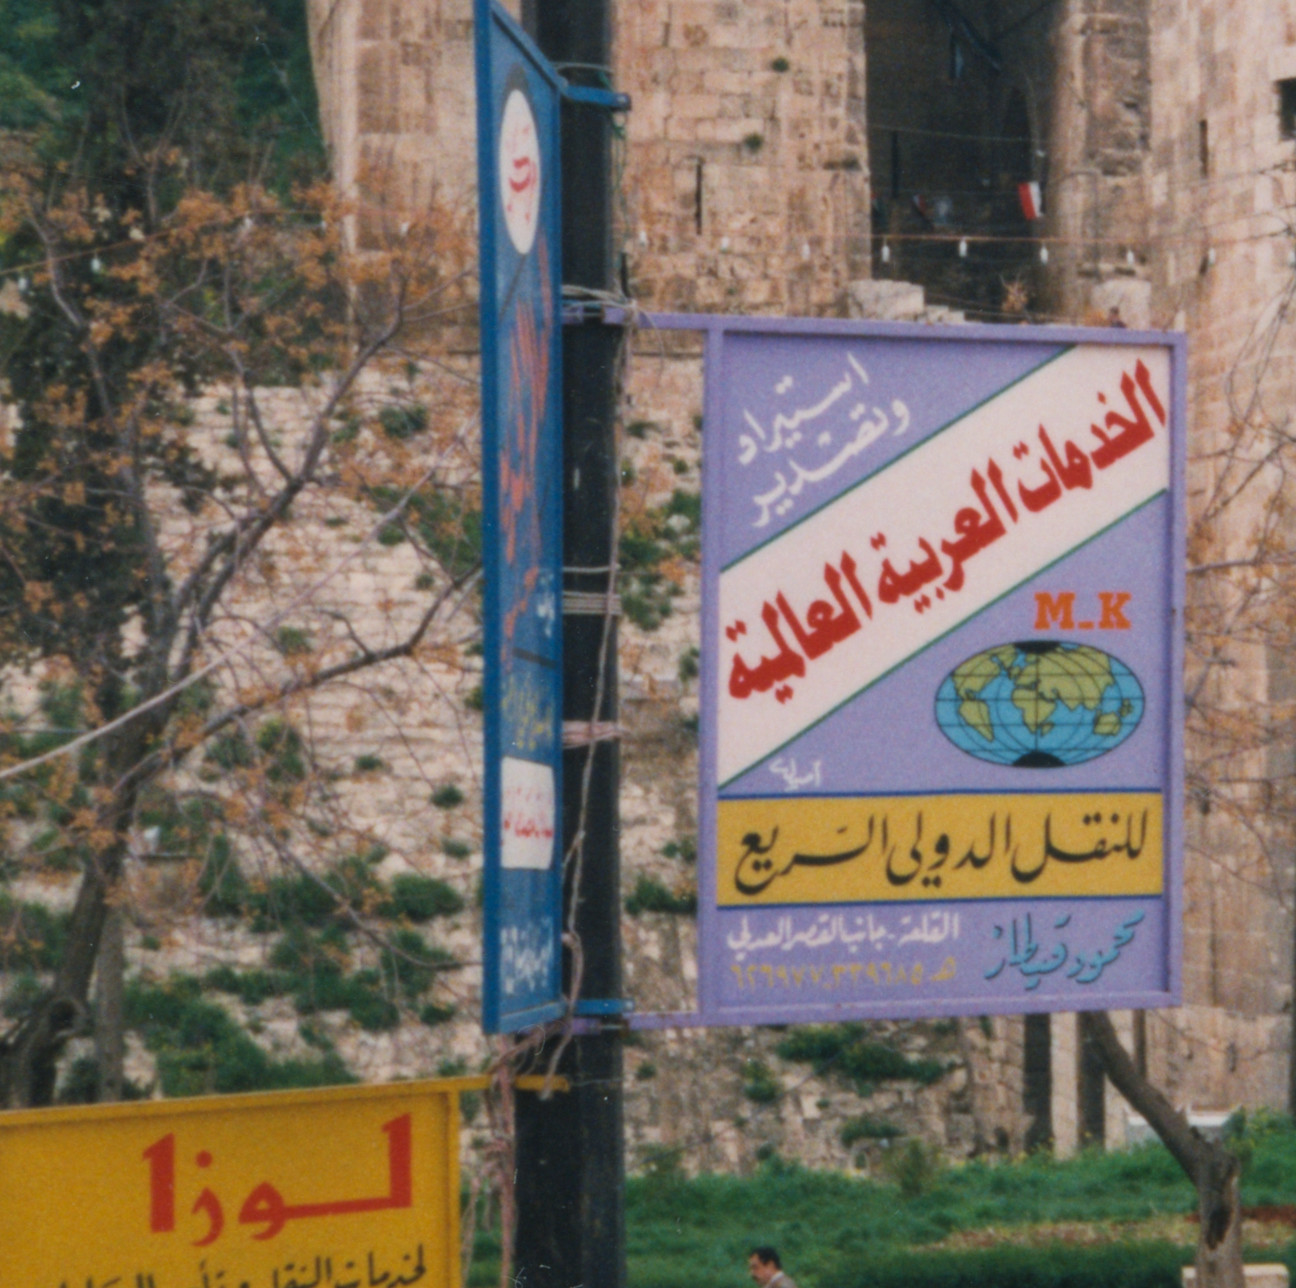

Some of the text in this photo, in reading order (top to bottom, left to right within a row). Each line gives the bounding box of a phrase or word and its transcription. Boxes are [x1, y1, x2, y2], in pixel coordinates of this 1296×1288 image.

[738, 350, 870, 466] استيراد
[725, 357, 1167, 705] الخدمات العربية العالمية
[1010, 808, 1149, 884] للنقل
[897, 910, 960, 949] القلعة
[1066, 909, 1147, 984] محمود
